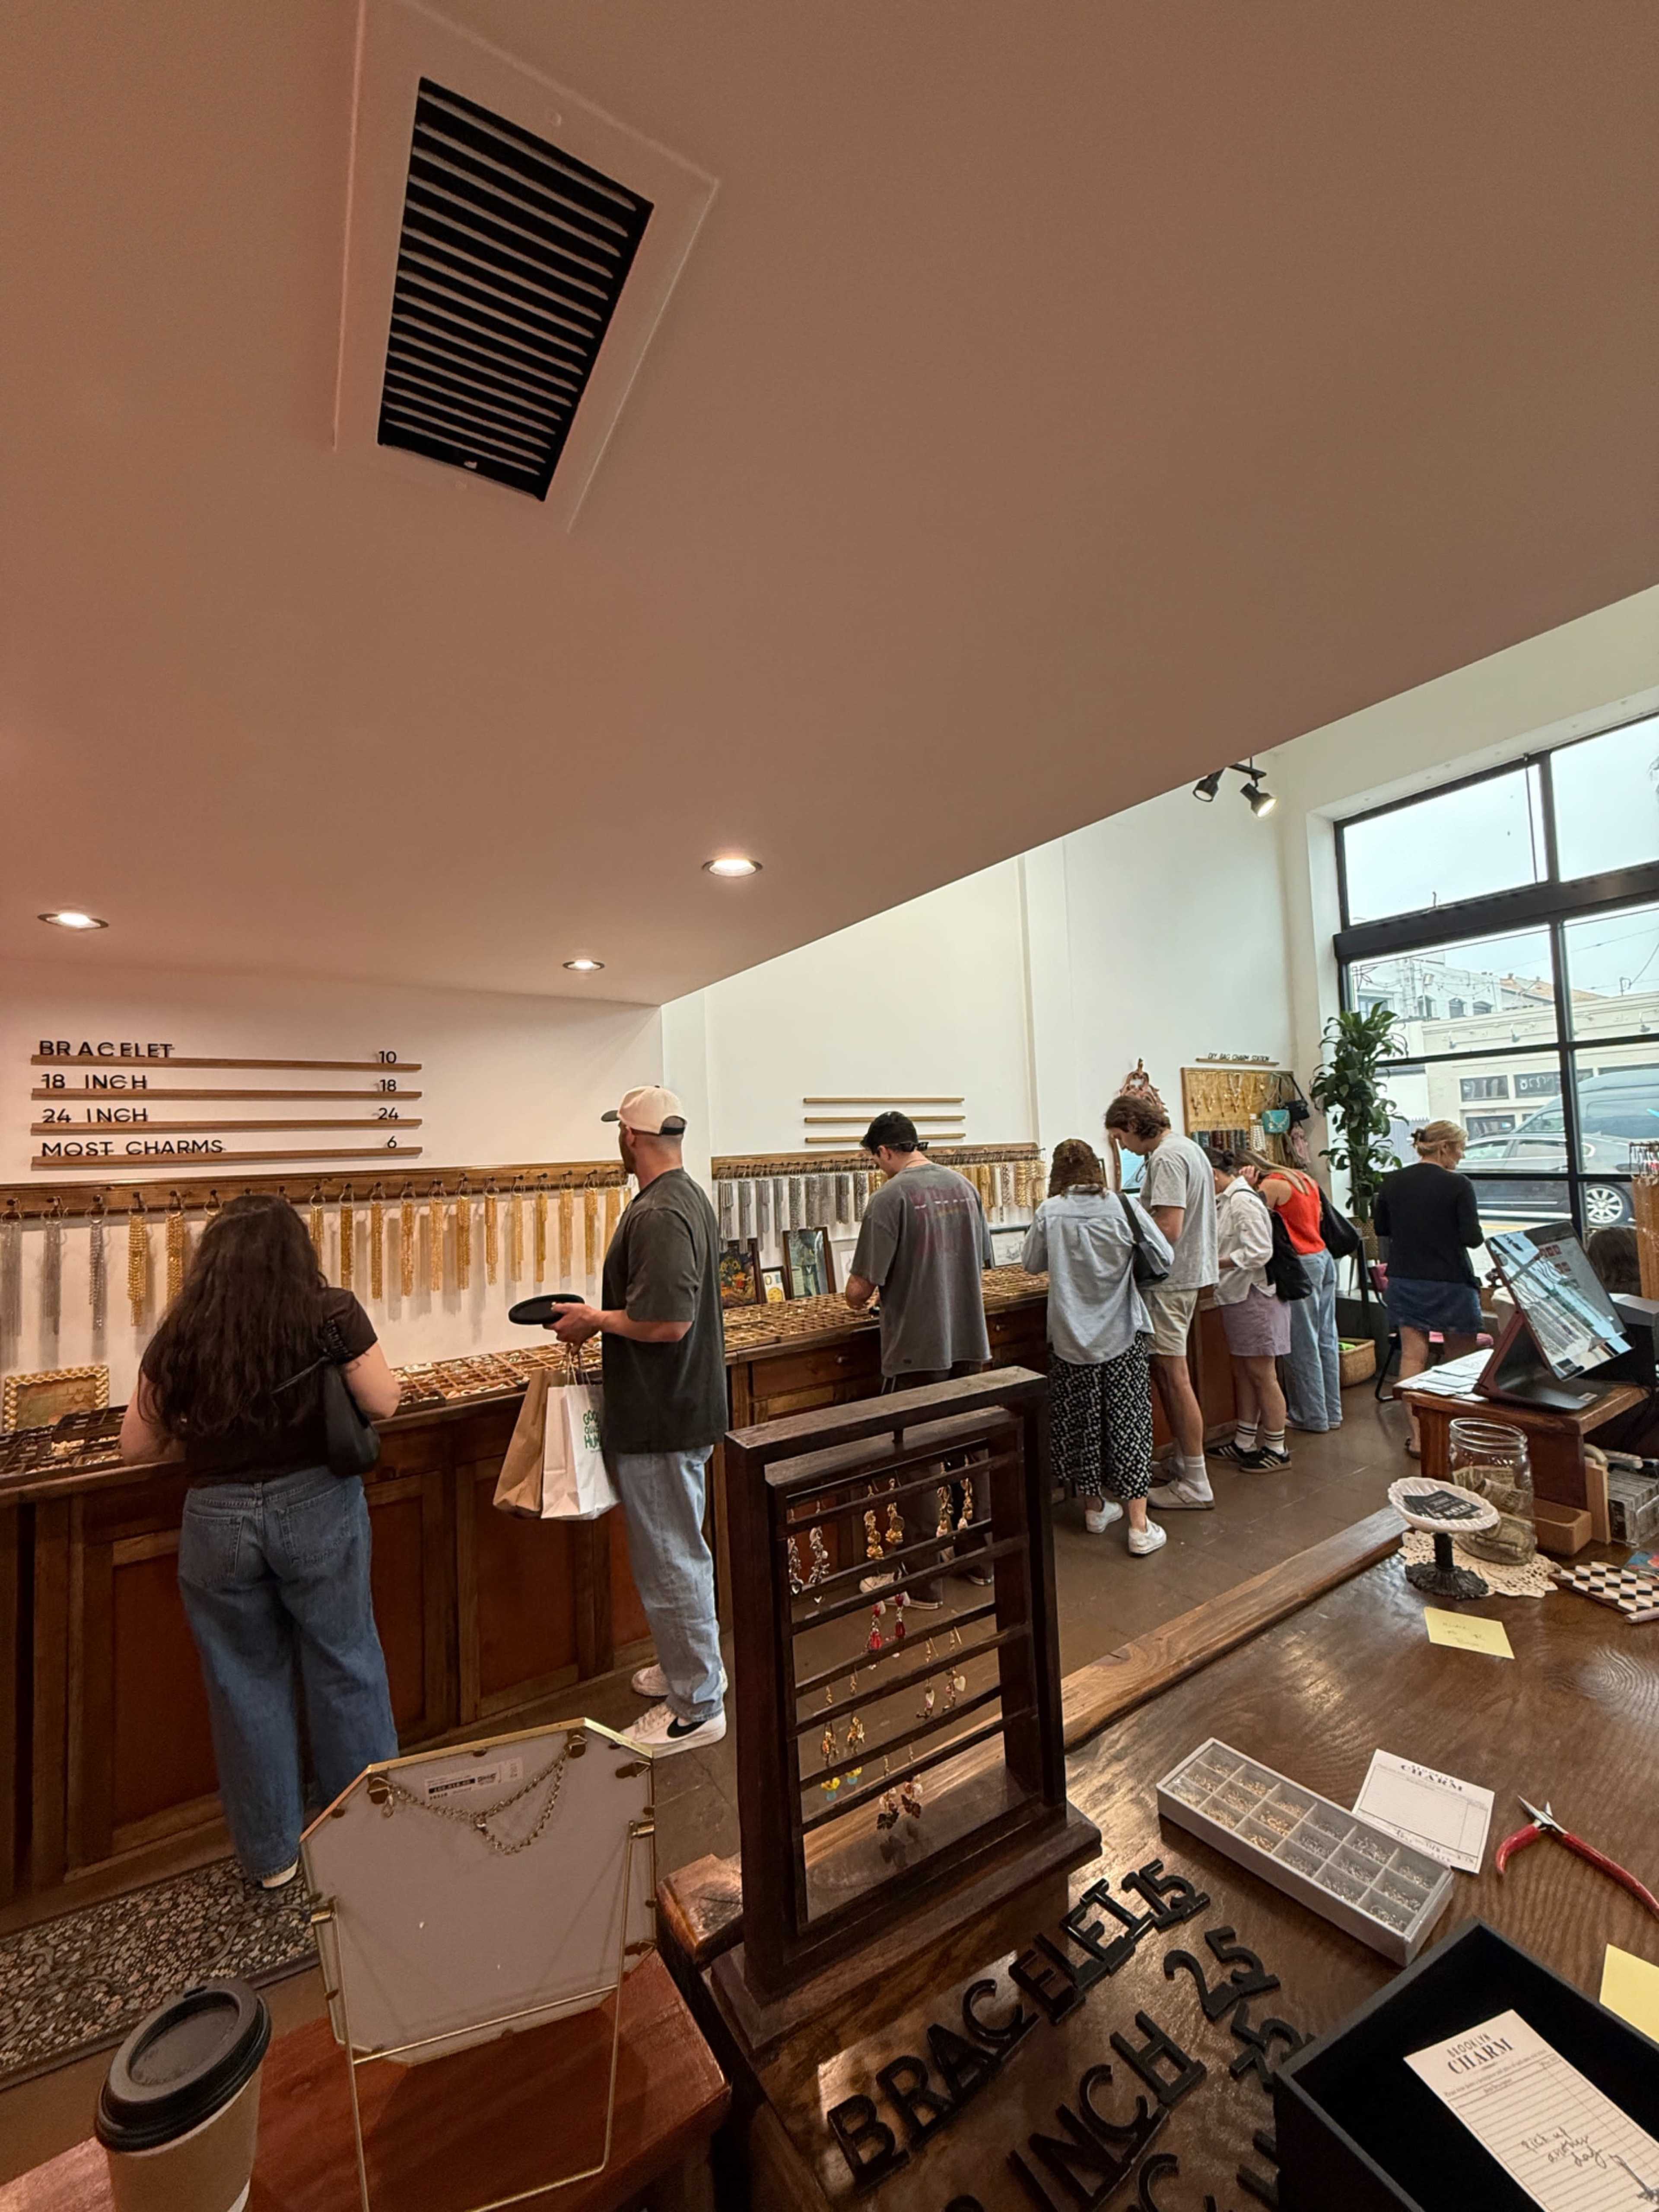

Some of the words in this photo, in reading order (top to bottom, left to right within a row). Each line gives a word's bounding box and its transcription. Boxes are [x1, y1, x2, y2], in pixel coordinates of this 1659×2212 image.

[39, 1040, 173, 1058] BRACELET
[378, 1051, 397, 1064] 10
[41, 1074, 66, 1089] 18
[85, 1074, 147, 1089] INCH
[380, 1079, 397, 1092] 18
[42, 1108, 71, 1123] 24
[87, 1108, 148, 1122] INCH
[378, 1107, 399, 1120] 24
[42, 1141, 113, 1157] MOST
[125, 1139, 223, 1155] CHARMS
[387, 1135, 397, 1148] 6
[826, 1878, 1153, 2188] BRACELET
[1122, 1859, 1210, 1931] 15
[1446, 2033, 1493, 2058] BROOKLYN
[1447, 2037, 1513, 2075] CHARM
[1007, 2010, 1206, 2212] INCH
[1163, 1926, 1280, 2023] 25
